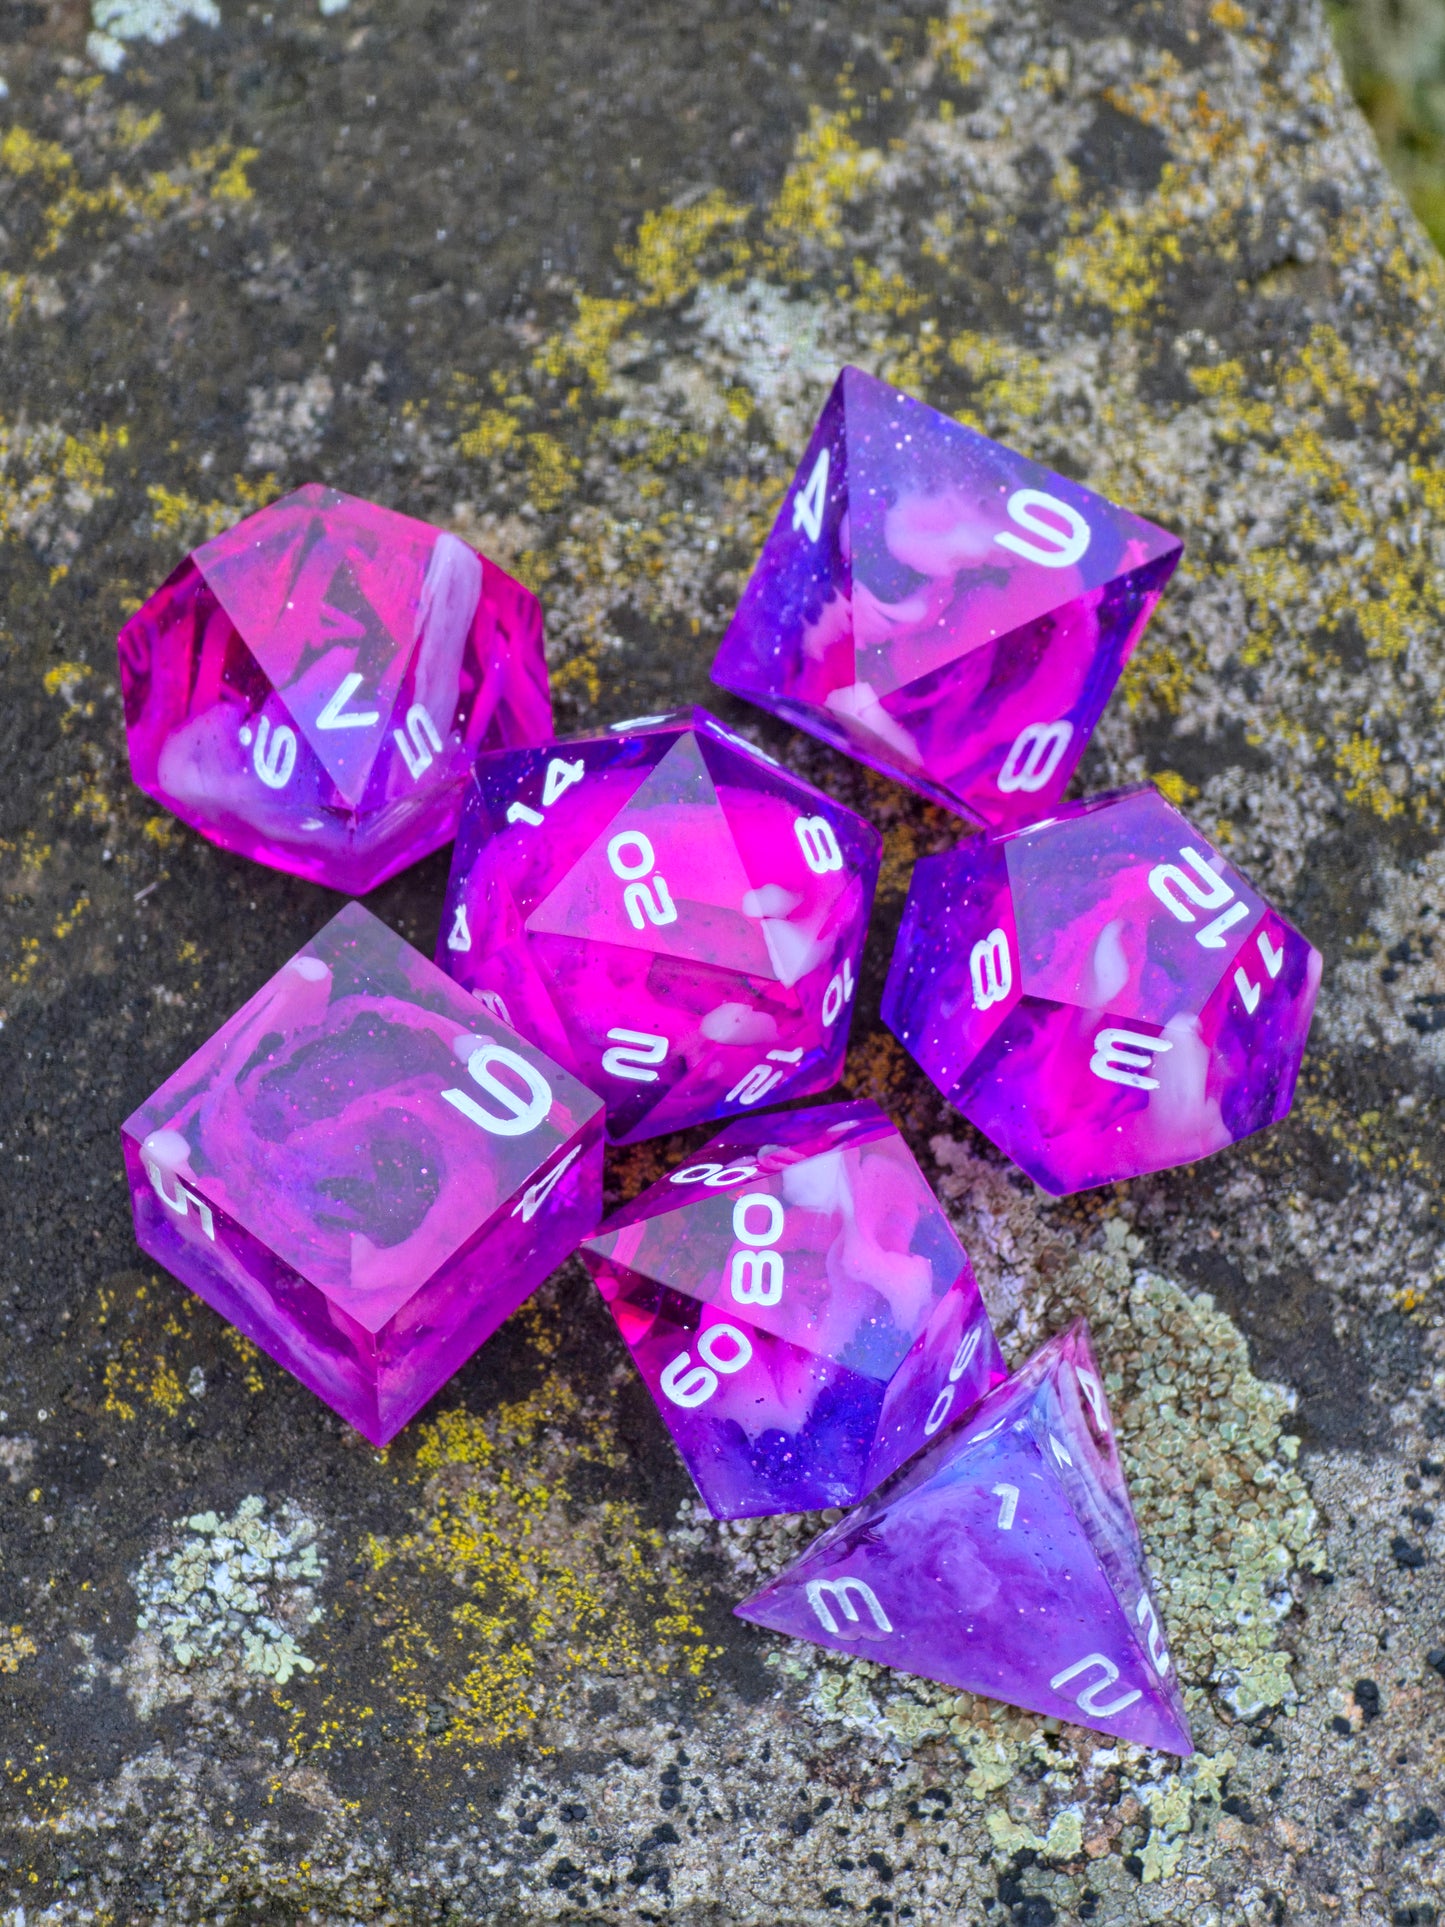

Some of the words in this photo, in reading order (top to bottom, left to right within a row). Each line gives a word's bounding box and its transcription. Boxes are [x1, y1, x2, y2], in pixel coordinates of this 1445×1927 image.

[793, 448, 830, 543] 4
[316, 673, 379, 730] 7
[393, 704, 442, 779] 5
[994, 721, 1073, 792] 8
[507, 758, 585, 826] 14
[794, 816, 843, 874] 8
[607, 830, 678, 930] 20
[1148, 846, 1250, 948] 12
[447, 905, 472, 952] 4
[821, 958, 855, 1027] 10
[969, 927, 1012, 1011] 8
[1234, 930, 1283, 1014] 11
[602, 1027, 669, 1081] 2
[725, 1047, 804, 1105] 12
[1089, 1027, 1174, 1090] 3
[147, 1160, 215, 1241] 5
[511, 1144, 582, 1223] 4
[731, 1192, 784, 1306] 80
[991, 1483, 1020, 1530] 1
[806, 1576, 893, 1633] 3
[1050, 1653, 1143, 1717] 2
